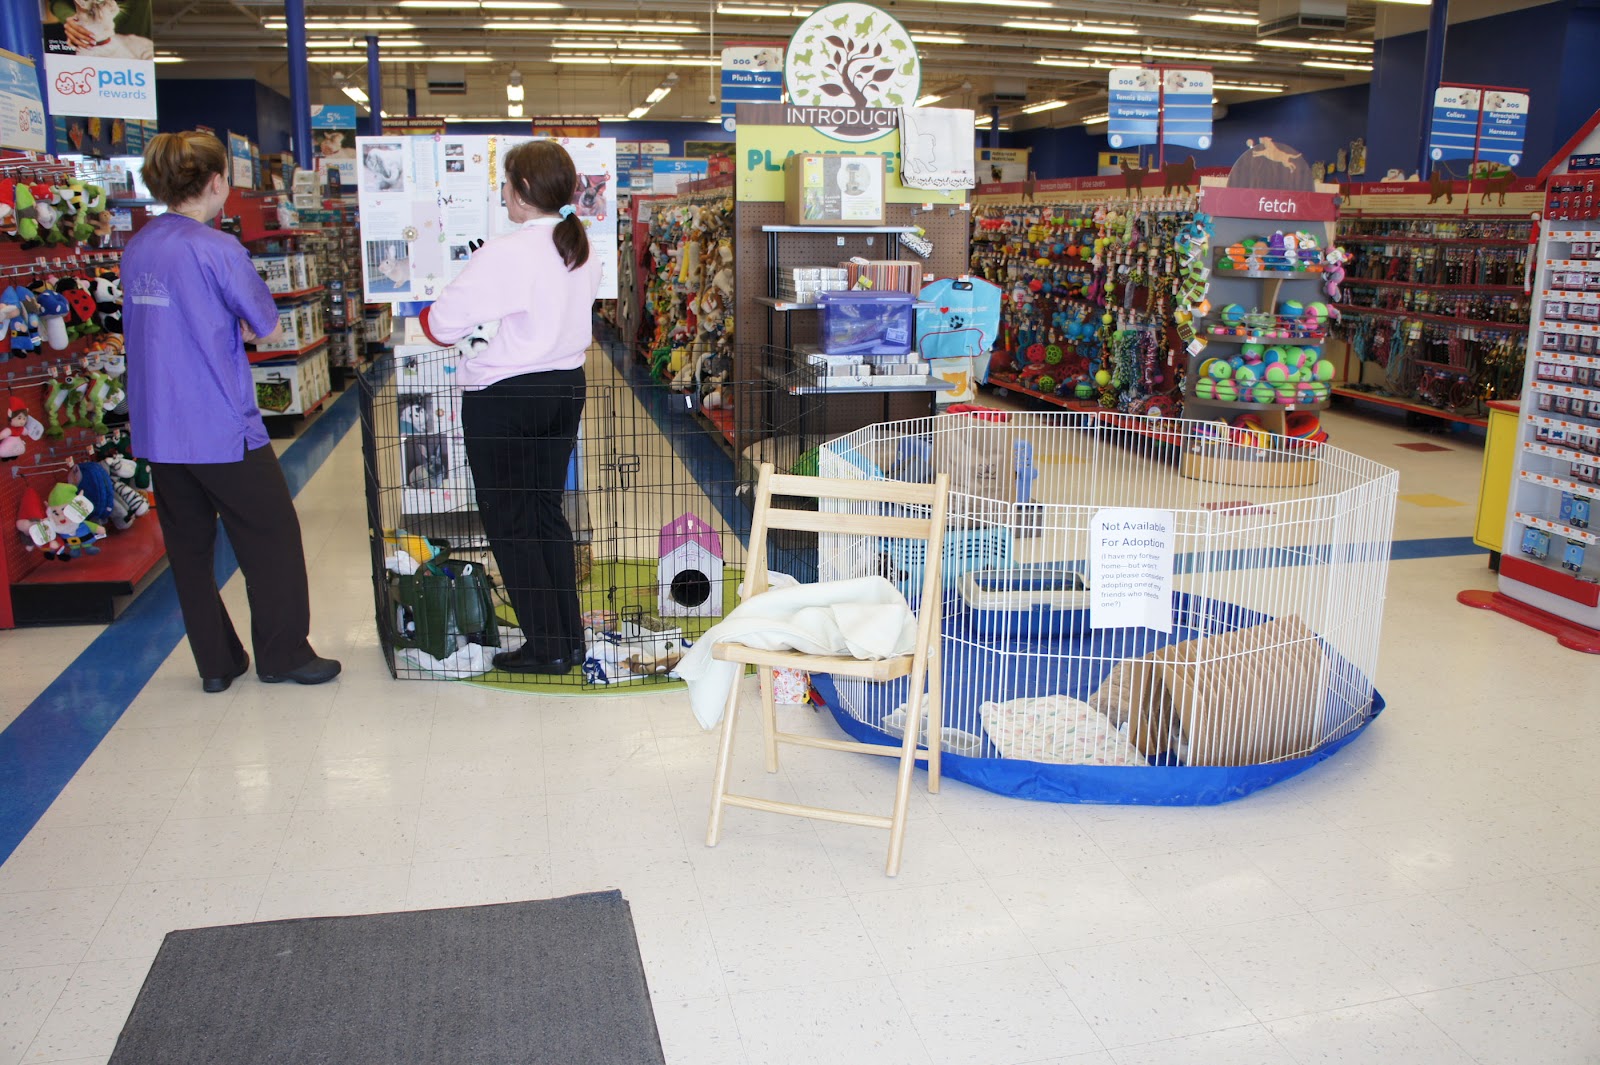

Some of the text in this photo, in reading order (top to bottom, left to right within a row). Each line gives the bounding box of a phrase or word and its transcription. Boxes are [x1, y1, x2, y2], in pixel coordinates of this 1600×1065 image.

[98, 69, 146, 88] pals
[731, 74, 771, 83] Plush Toys
[98, 89, 147, 100] rewards
[326, 112, 341, 123] 5%
[787, 108, 898, 126] INTRODUCI
[1446, 111, 1466, 119] Collars
[1489, 111, 1520, 120] Retractable
[1488, 128, 1517, 136] Harnesses
[674, 161, 687, 171] 5%
[1258, 196, 1297, 213] fetch
[1102, 521, 1166, 533] Not Available
[1102, 537, 1165, 549] For Adoption
[1141, 572, 1164, 581] consider
